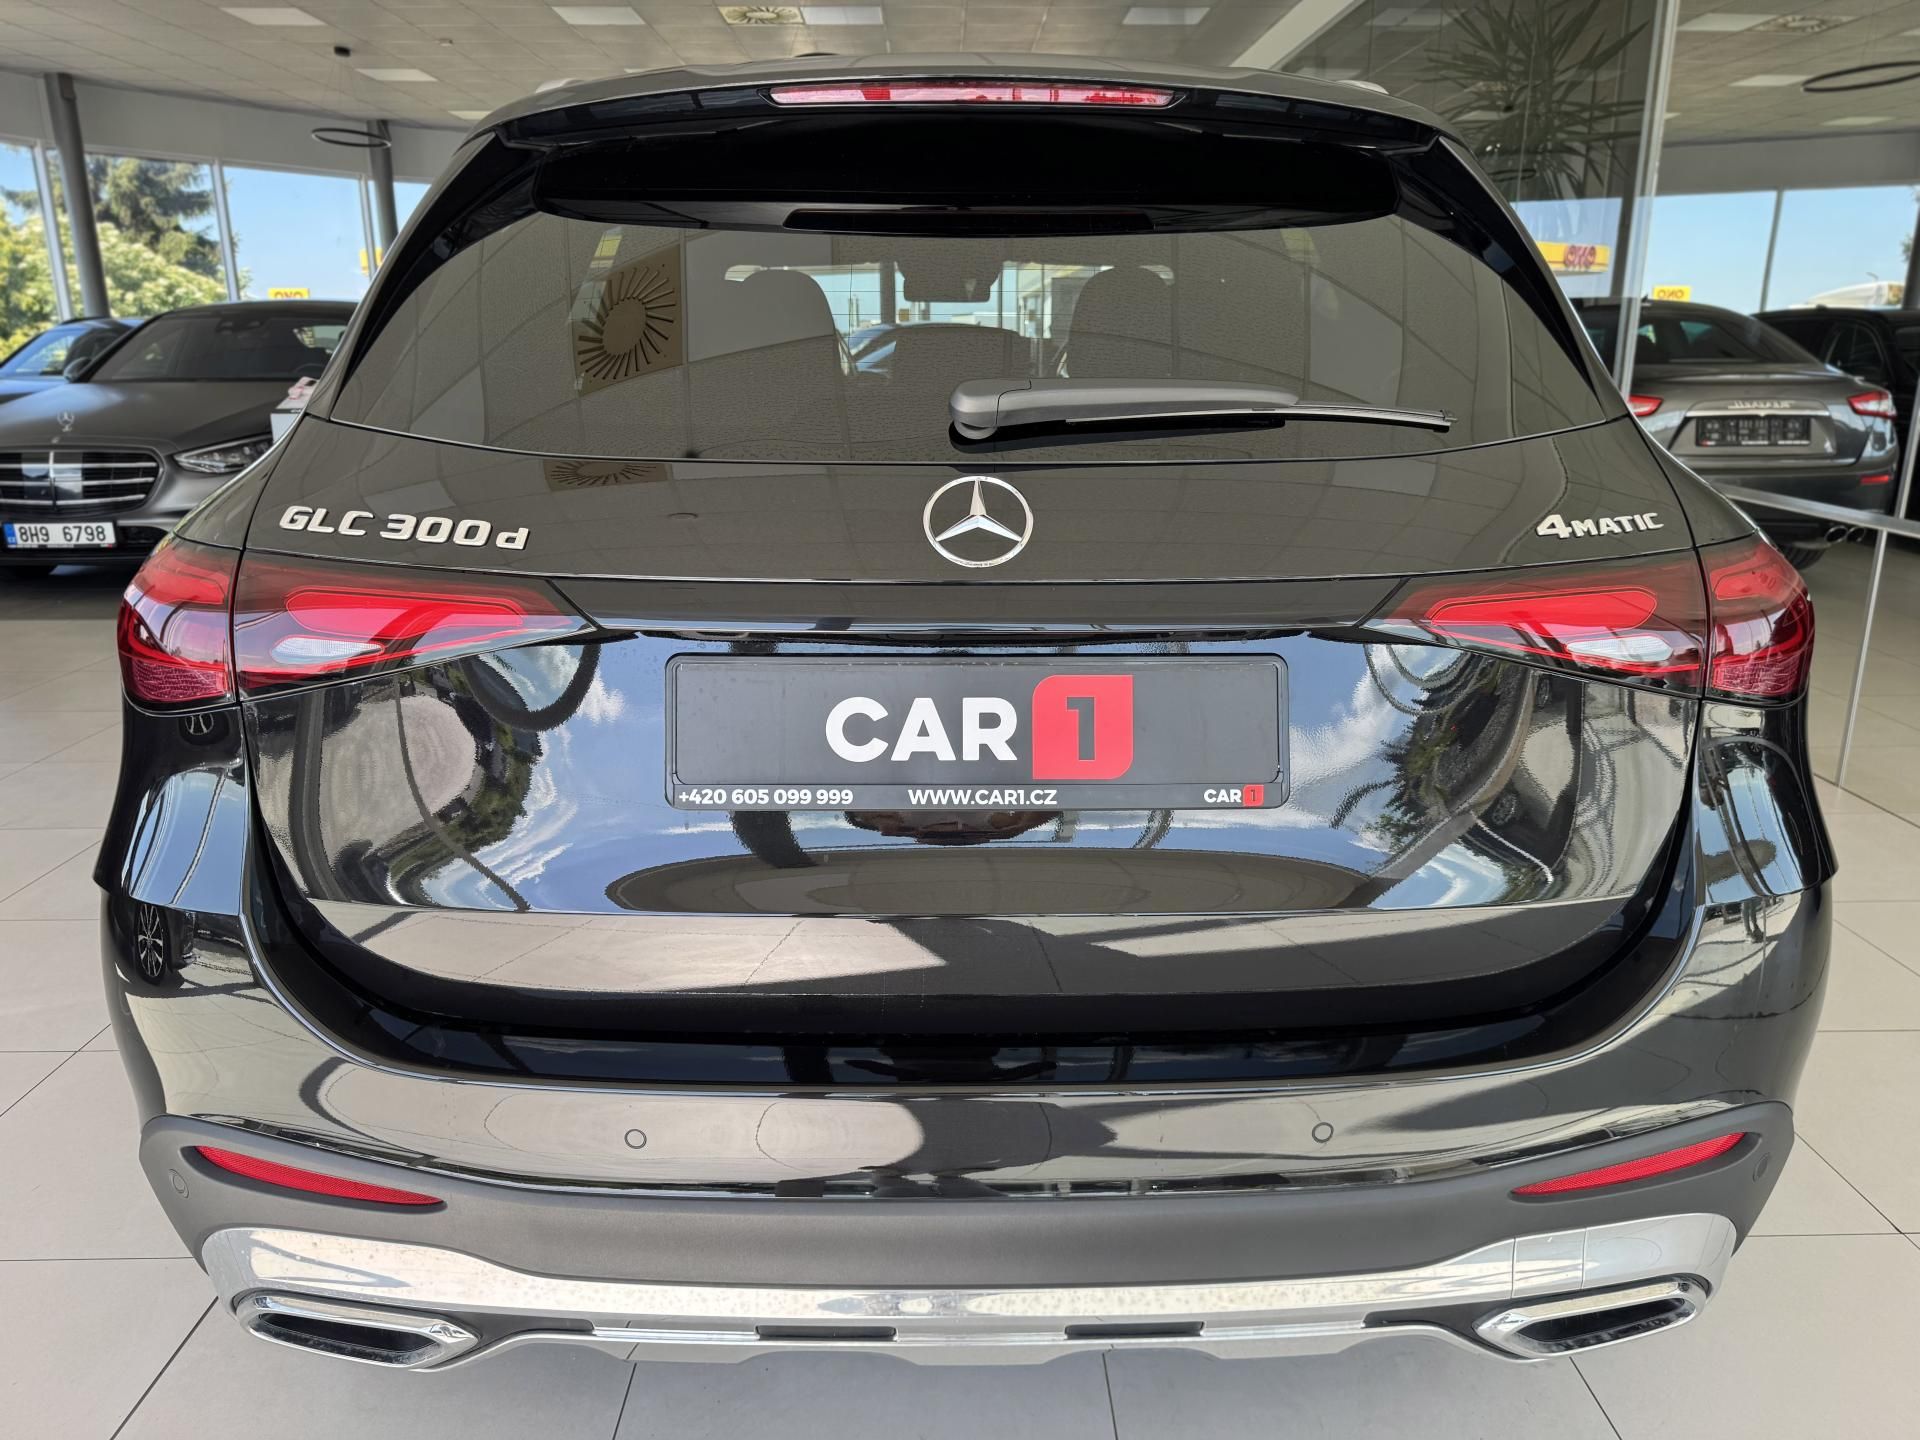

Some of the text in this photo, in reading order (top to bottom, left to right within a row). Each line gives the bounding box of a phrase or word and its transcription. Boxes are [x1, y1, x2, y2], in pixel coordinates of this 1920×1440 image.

[18, 525, 106, 543] 8H9 6798
[279, 505, 529, 550] GLC 300 d
[1536, 512, 1665, 539] 4MATIC
[678, 788, 854, 805] +420 605 099 999
[907, 788, 1058, 806] WWW.CAR1.CZ
